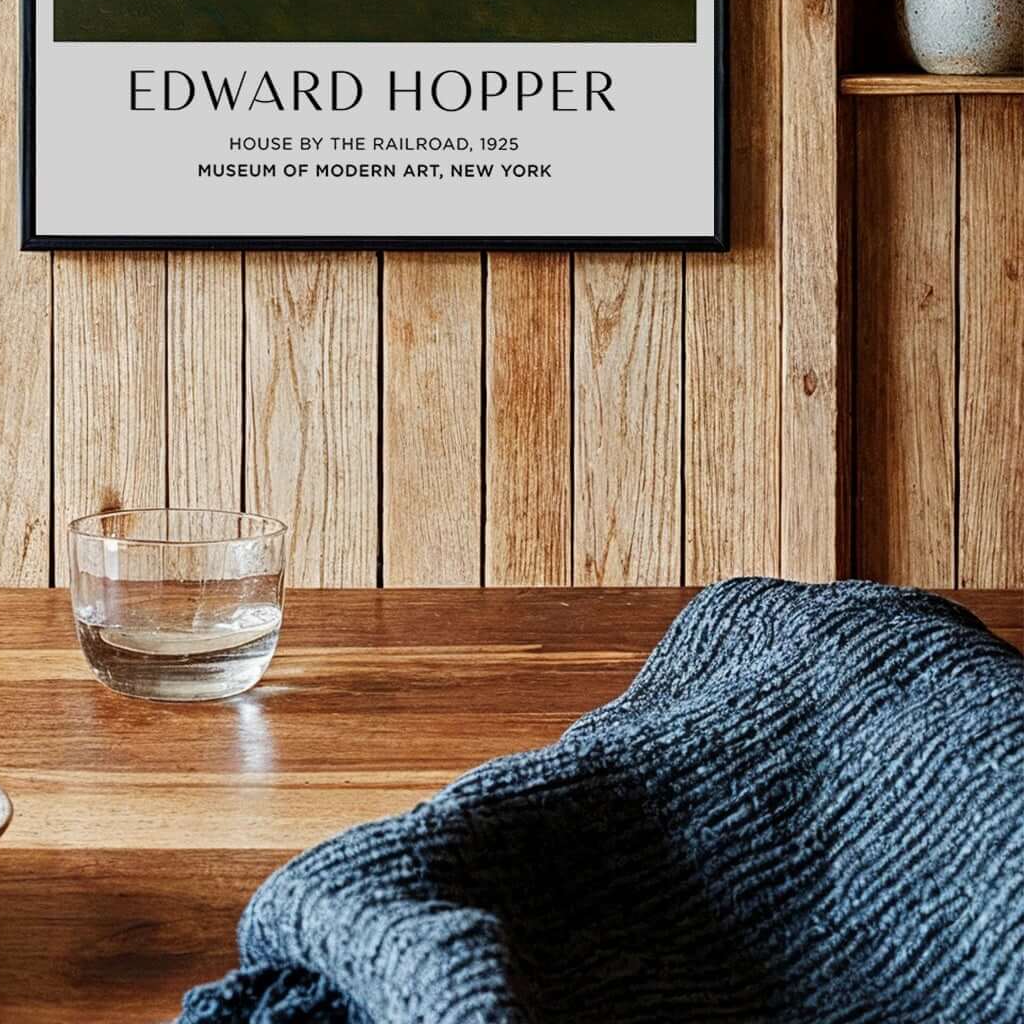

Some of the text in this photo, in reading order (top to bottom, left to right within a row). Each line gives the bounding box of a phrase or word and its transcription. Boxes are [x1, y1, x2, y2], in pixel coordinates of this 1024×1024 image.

[130, 69, 616, 112] EDWARD HOPPER
[229, 137, 520, 153] HOUSE BY THE RAILROAD, 1925
[198, 164, 552, 180] MUSEUM OF MODERN ART, NEW YORK
